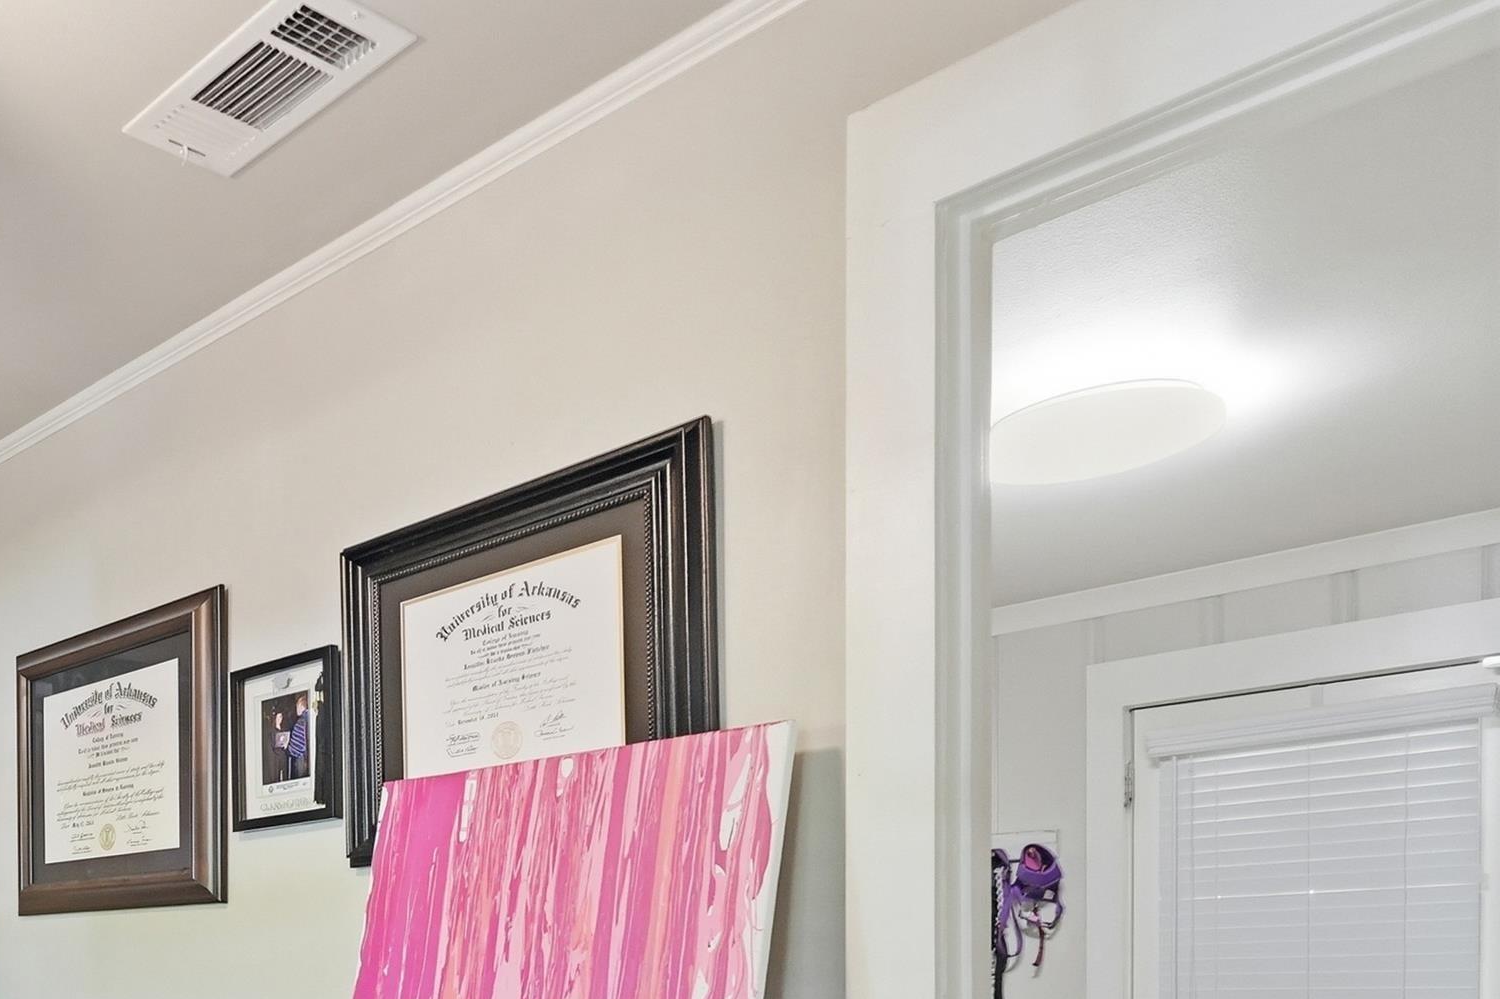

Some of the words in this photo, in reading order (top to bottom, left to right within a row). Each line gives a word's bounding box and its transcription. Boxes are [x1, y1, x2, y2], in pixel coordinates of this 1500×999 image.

[435, 592, 499, 642] University
[500, 583, 516, 601] of
[517, 580, 582, 609] Arkansas
[462, 620, 506, 641] Medical
[507, 609, 552, 630] Sciences
